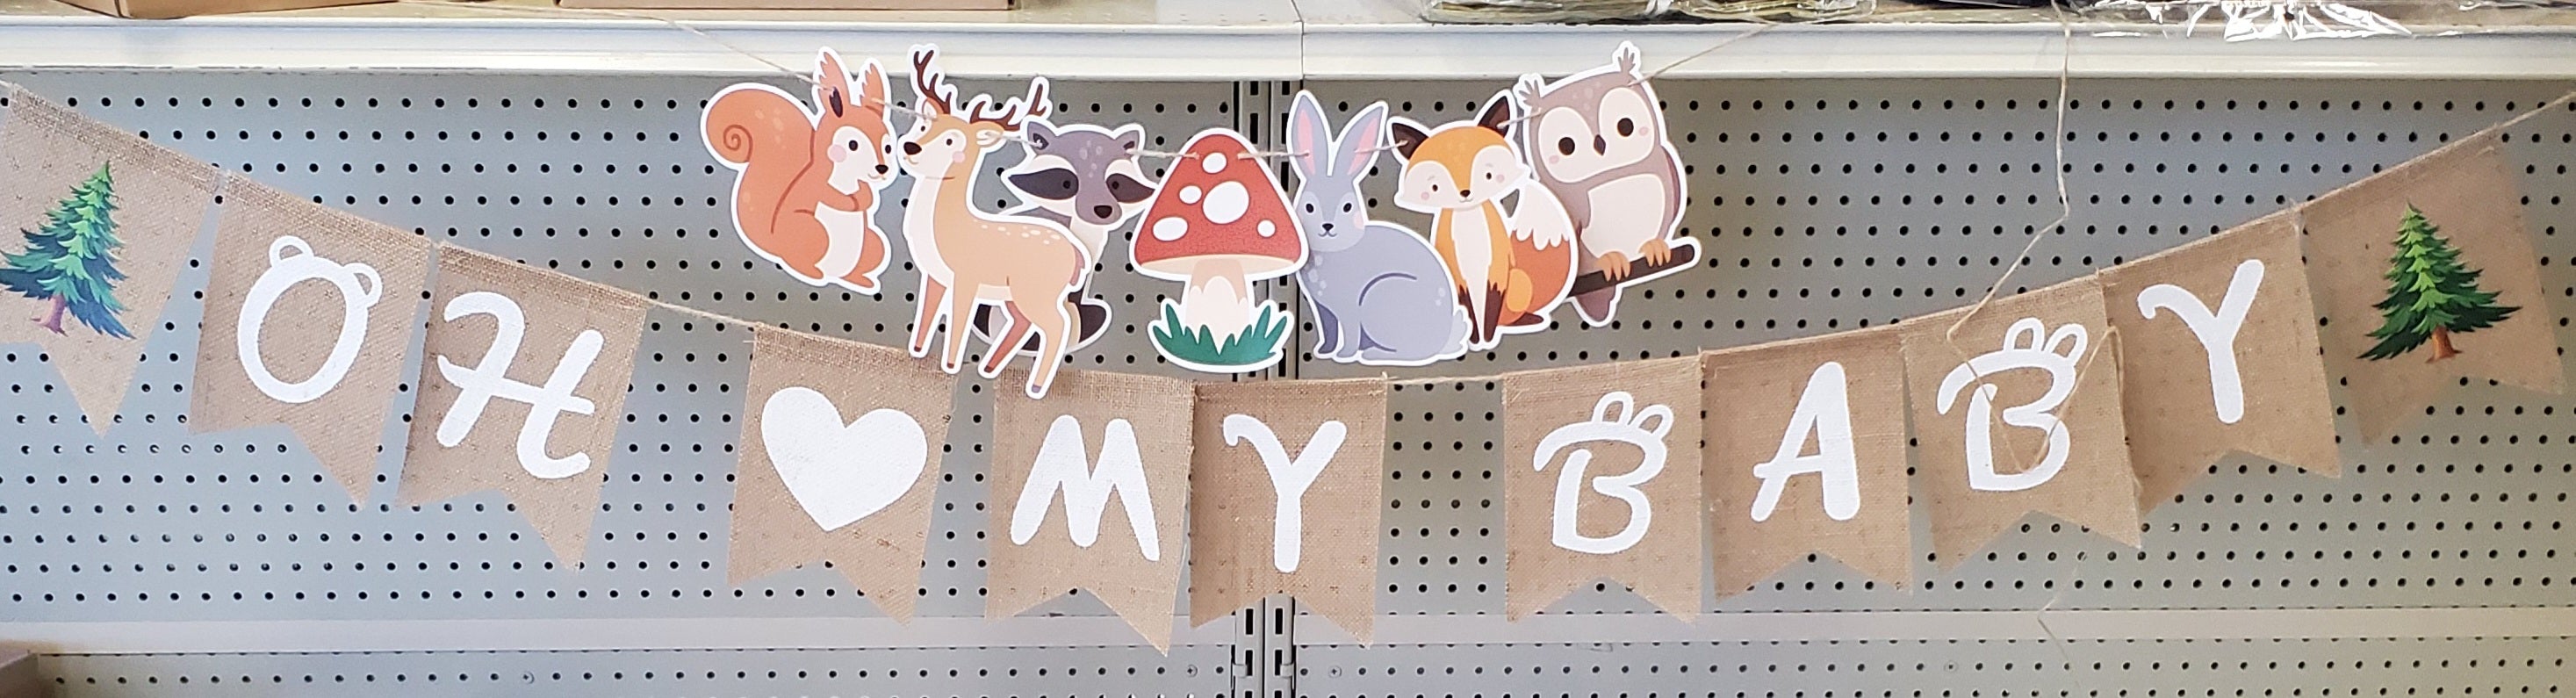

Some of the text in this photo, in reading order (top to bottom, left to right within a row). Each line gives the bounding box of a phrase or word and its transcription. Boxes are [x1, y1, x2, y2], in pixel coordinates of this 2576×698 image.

[237, 235, 2265, 573] OH MY BABY
